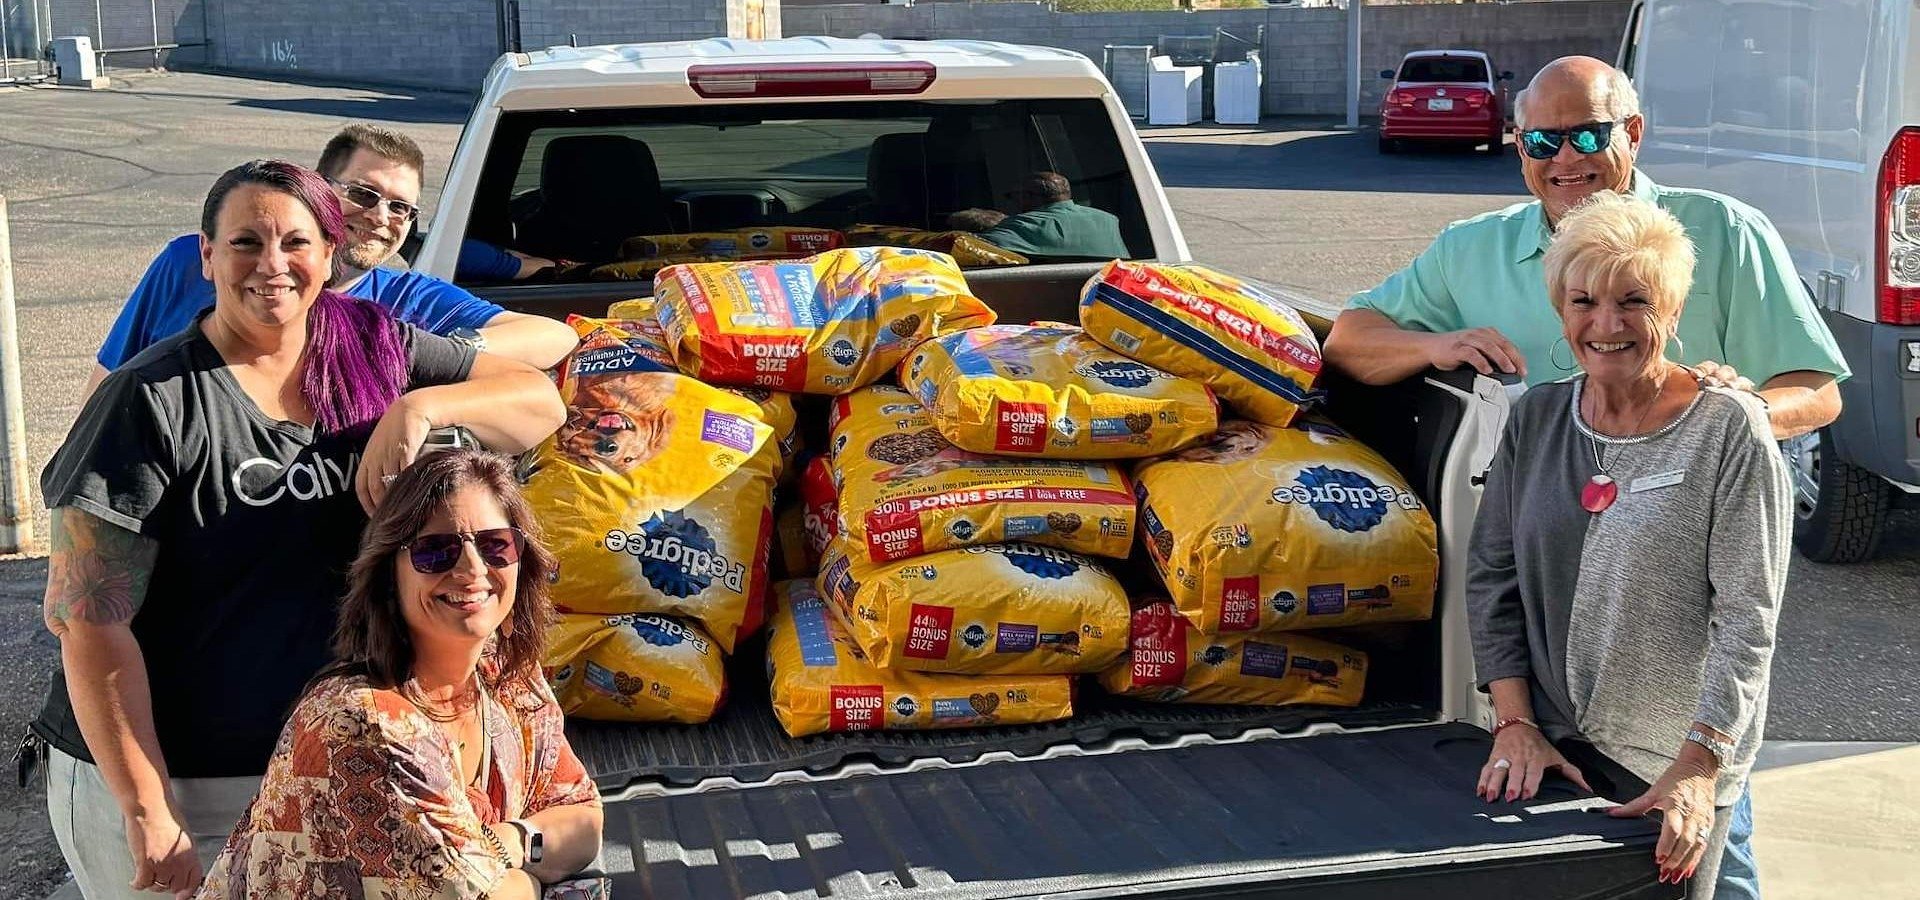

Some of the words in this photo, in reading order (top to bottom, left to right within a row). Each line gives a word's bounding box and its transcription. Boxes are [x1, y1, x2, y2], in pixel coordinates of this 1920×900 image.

[1146, 278, 1215, 316] BONUS
[1215, 309, 1253, 336] SIZE
[1283, 342, 1318, 365] FREE
[743, 343, 800, 358] BONUS
[572, 355, 637, 374] ADULT
[756, 358, 787, 373] SIZE
[755, 375, 785, 387] 30lb
[1002, 412, 1046, 424] BONUS
[1011, 423, 1035, 434] SIZE
[1011, 436, 1032, 446] 30lb
[231, 452, 360, 507] Calv
[874, 499, 905, 515] 30lb
[909, 490, 981, 510] BONUS
[984, 489, 1024, 500] SIZE
[1059, 489, 1087, 500] FREE
[1272, 484, 1422, 511] Pedigree
[872, 528, 918, 545] BONUS
[884, 541, 909, 553] SIZE
[605, 530, 746, 595] Pedigree
[1225, 589, 1249, 601] 44lb
[1224, 599, 1256, 612] BONUS
[914, 614, 938, 628] 44lb
[1223, 612, 1247, 624] SIZE
[912, 626, 947, 641] BONUS
[909, 638, 934, 651] SIZE
[1134, 636, 1162, 650] 44lb
[1134, 649, 1176, 664] BONUS
[1133, 663, 1161, 677] SIZE
[835, 697, 882, 709] BONUS
[846, 709, 871, 720] SIZE
